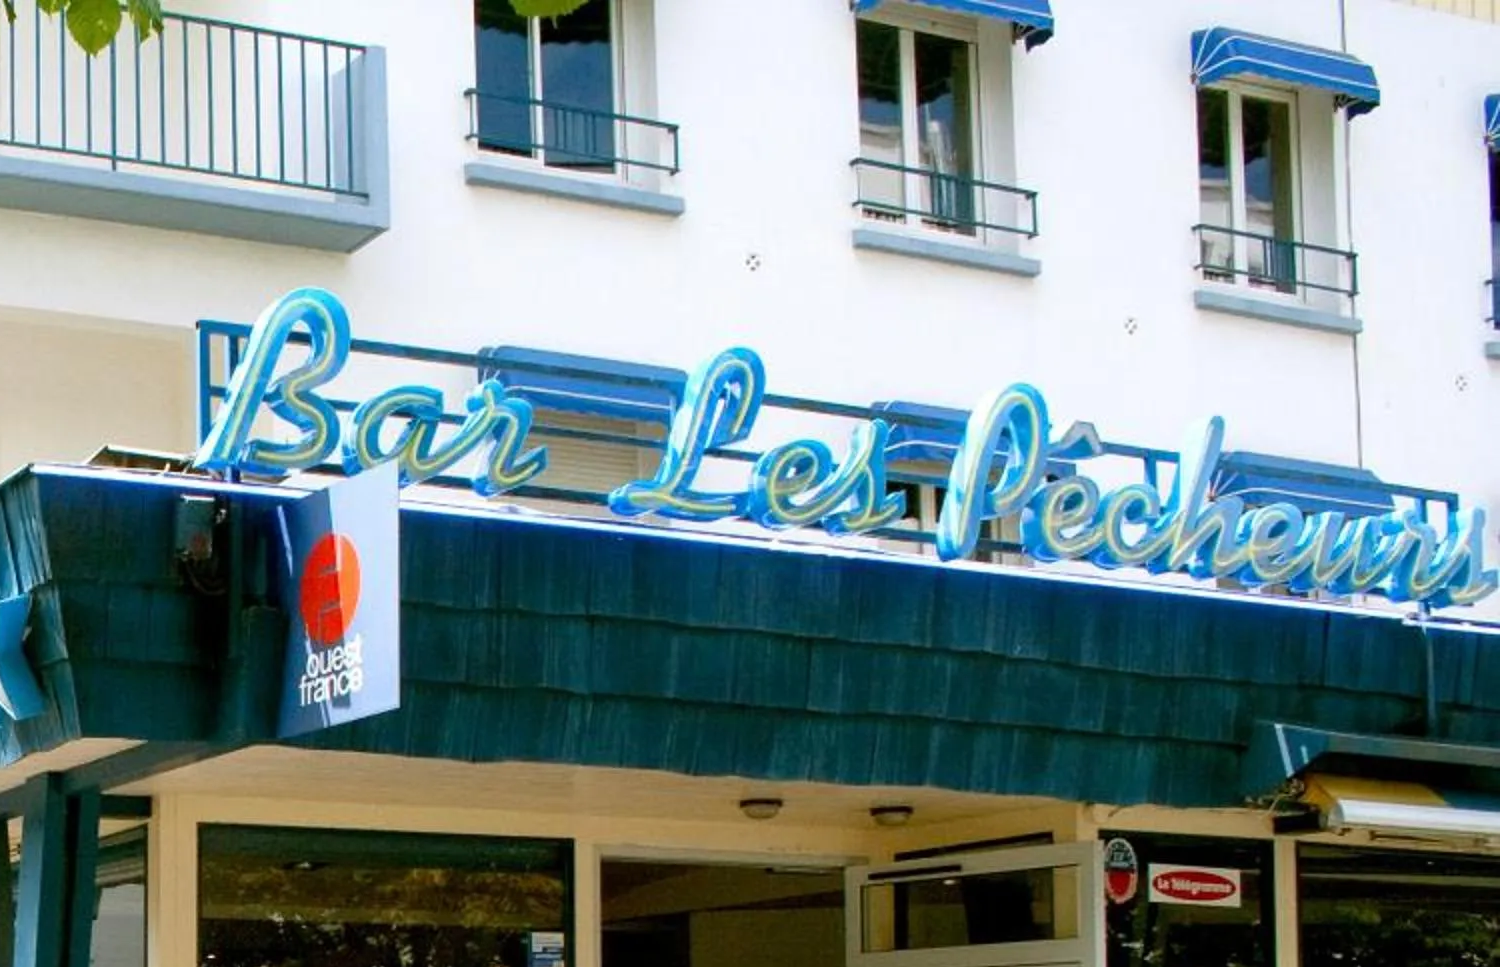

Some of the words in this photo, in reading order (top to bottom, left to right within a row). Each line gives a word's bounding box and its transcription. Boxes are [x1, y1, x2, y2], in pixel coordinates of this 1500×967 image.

[195, 287, 550, 498] Bar
[607, 347, 907, 537] Les
[936, 382, 1499, 609] Pêcheurs
[306, 633, 362, 678] ouest
[298, 667, 363, 707] france
